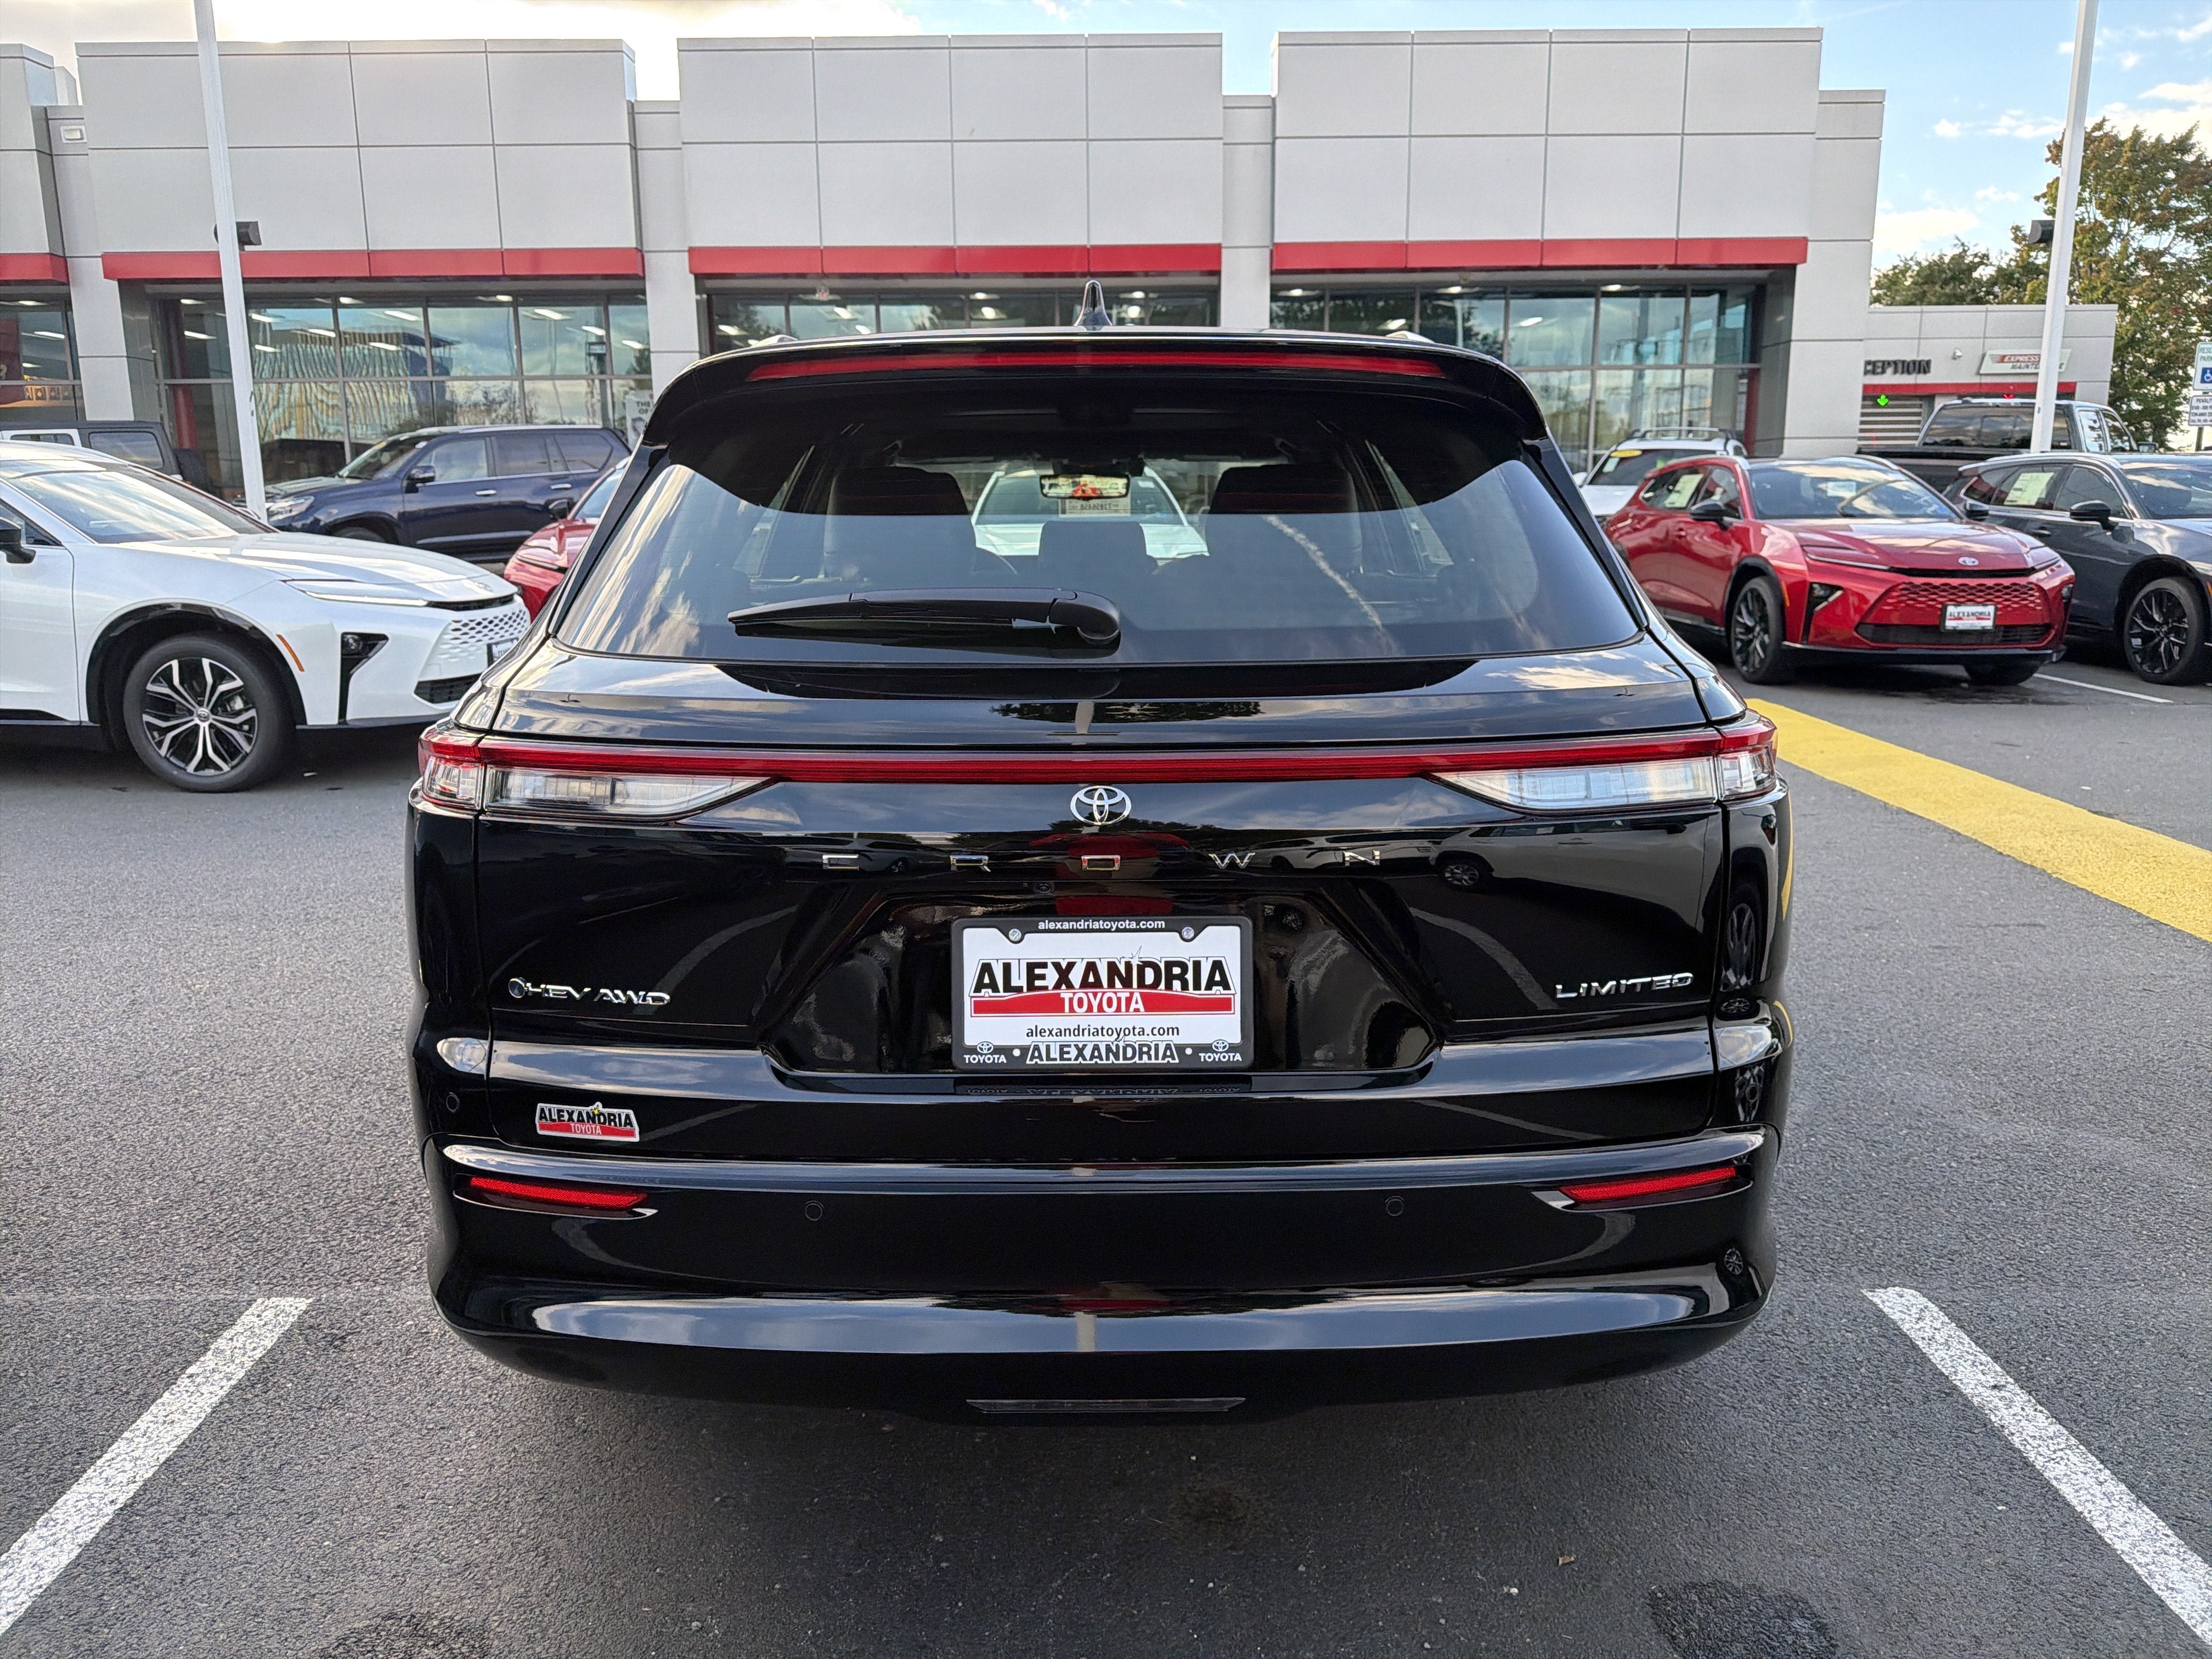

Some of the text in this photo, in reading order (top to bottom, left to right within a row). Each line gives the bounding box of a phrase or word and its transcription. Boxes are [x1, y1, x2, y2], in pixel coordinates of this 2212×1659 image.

[1037, 919, 1166, 931] alexandriatoyota.com
[972, 958, 1233, 995] ALEXANDRIA
[1555, 972, 1694, 998] LIMITED
[592, 989, 670, 1005] AWD
[1060, 992, 1146, 1013] TOYOTA
[1025, 1024, 1180, 1039] alexandriatoyota.com
[963, 1054, 1007, 1064] TOYOTA
[1026, 1041, 1180, 1064] ALEXANDRIA
[1198, 1052, 1242, 1063] TOYOTA
[538, 1105, 635, 1128] ALEXANDRIA
[569, 1123, 603, 1135] TOYOTA
